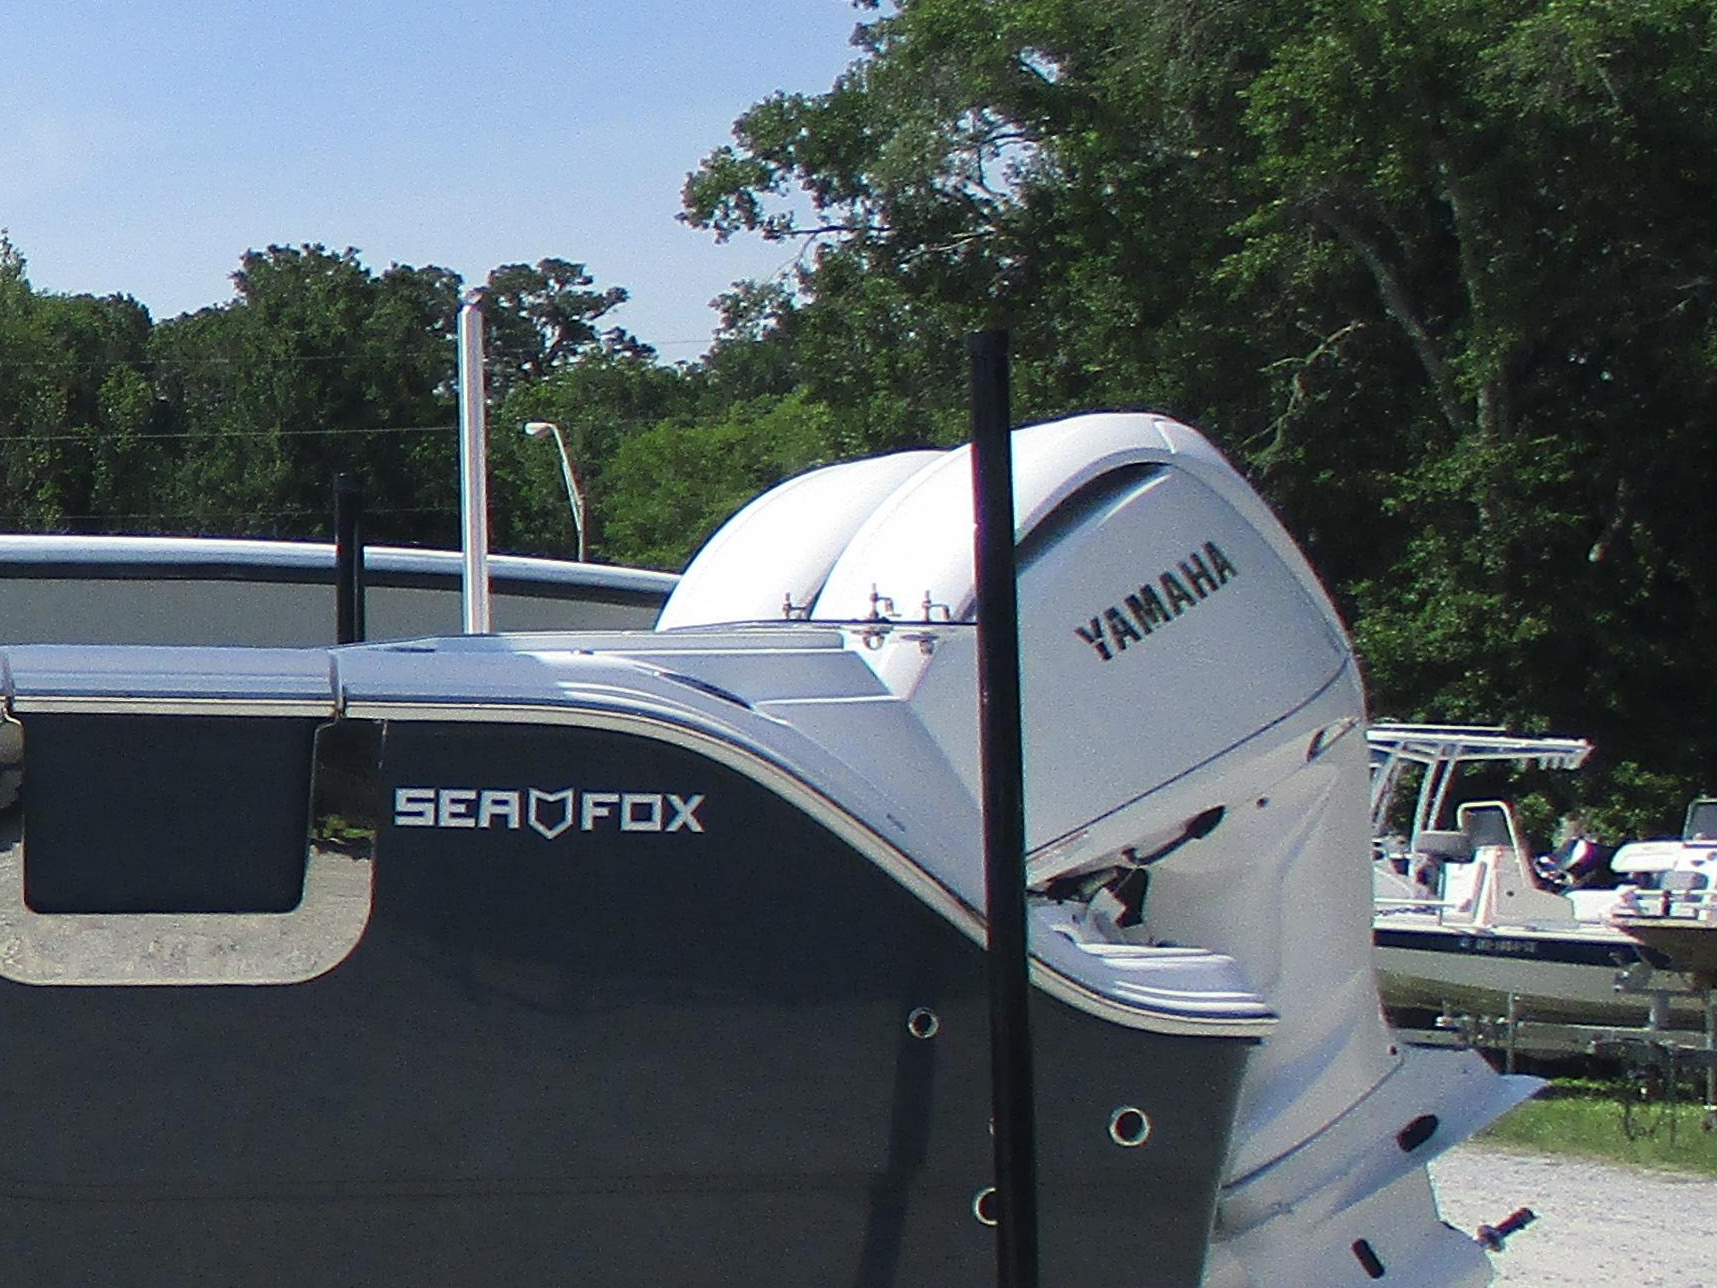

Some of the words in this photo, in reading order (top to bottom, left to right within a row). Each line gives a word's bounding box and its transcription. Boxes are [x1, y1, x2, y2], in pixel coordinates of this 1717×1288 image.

[1074, 540, 1239, 661] YAMAHA
[393, 787, 520, 830] SEA
[580, 792, 706, 833] FOX
